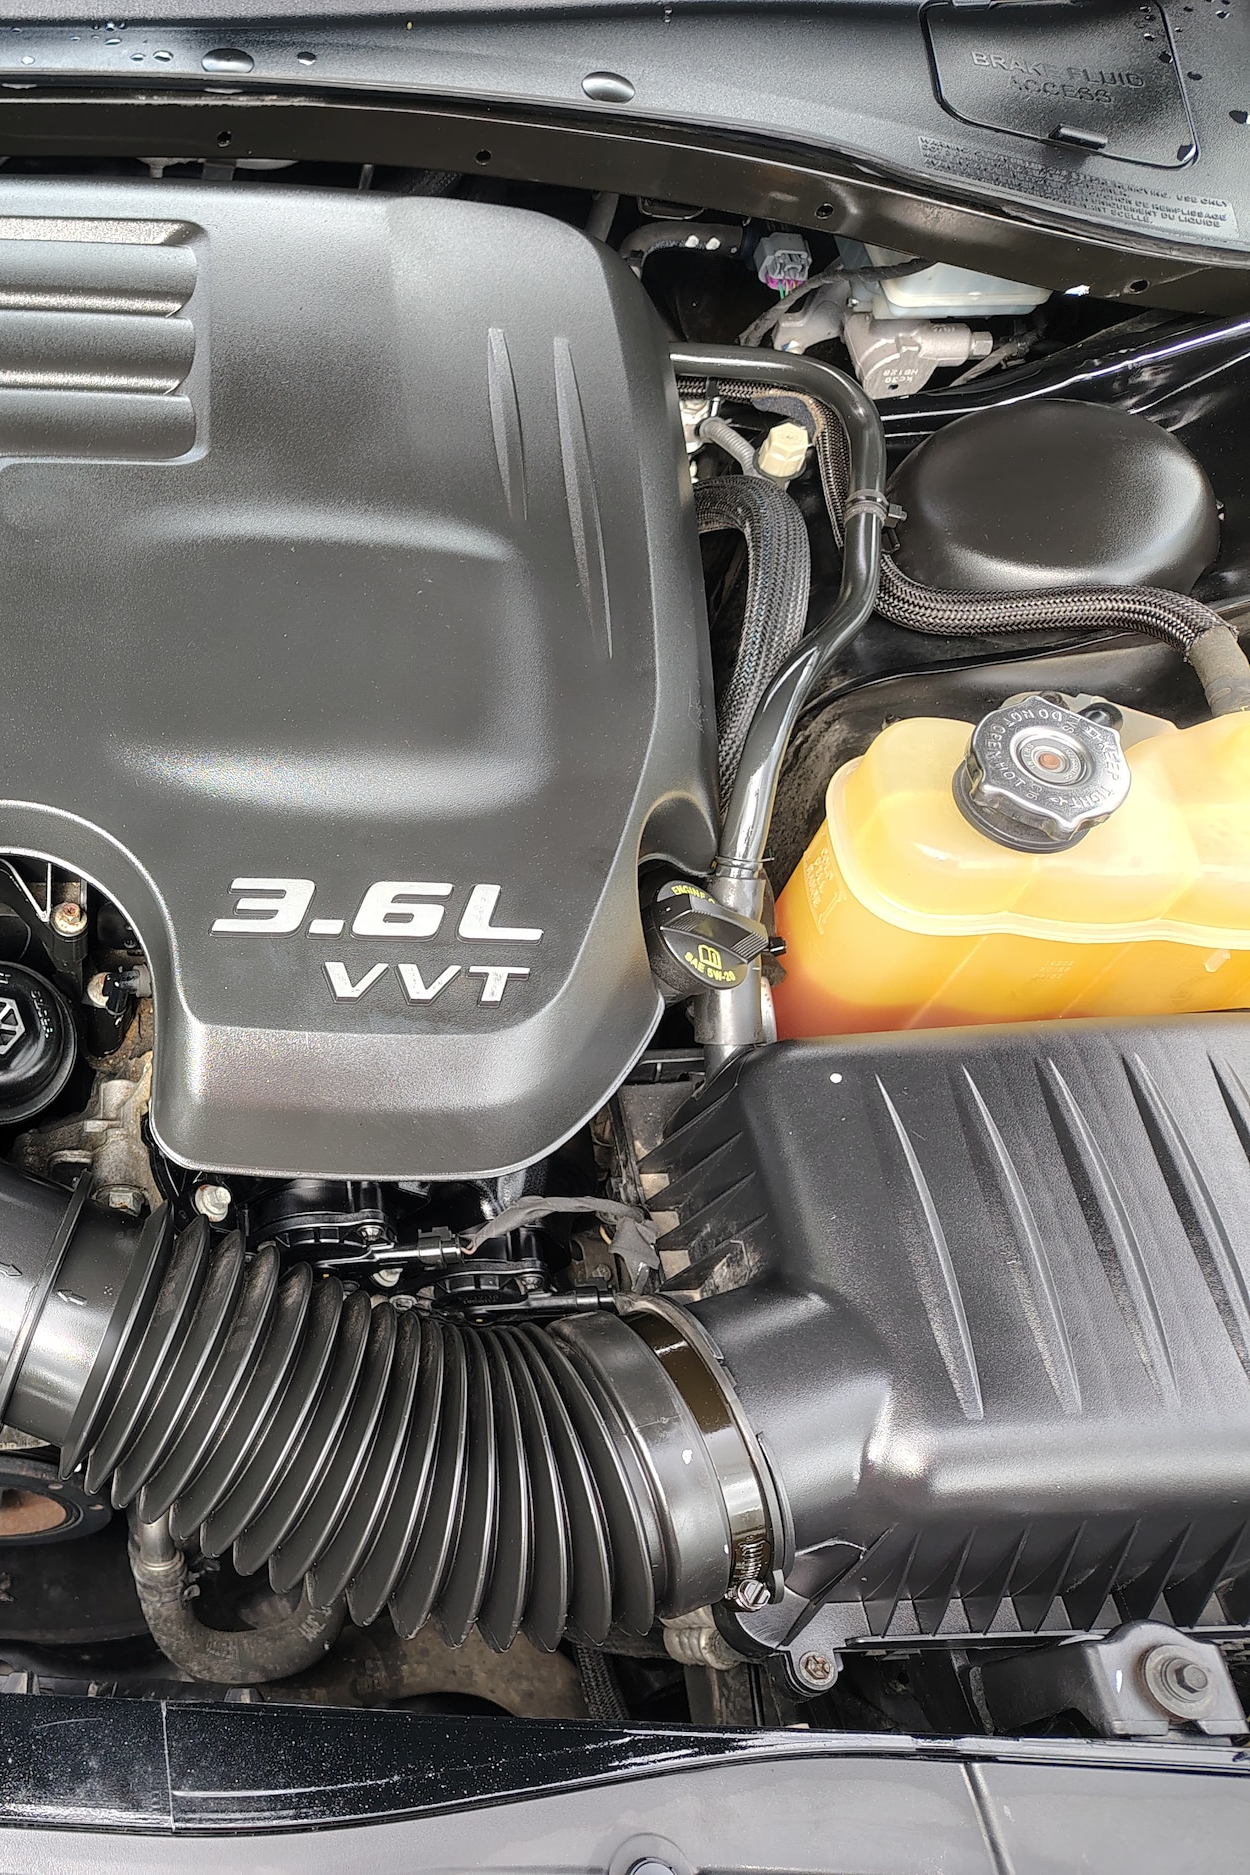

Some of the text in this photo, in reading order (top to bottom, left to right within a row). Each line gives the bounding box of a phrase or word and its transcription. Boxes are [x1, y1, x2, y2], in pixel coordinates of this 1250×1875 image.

[971, 51, 1145, 87] BRAKE FLUID
[1008, 75, 1113, 104] ACCESS
[1038, 708, 1063, 722] DO
[998, 761, 1026, 787] HOT
[1097, 742, 1122, 781] KEEP
[1071, 784, 1116, 809] TIGHT
[209, 876, 544, 946] 3.6L
[684, 952, 736, 982] SAE 5W-20
[321, 961, 531, 1009] VVT
